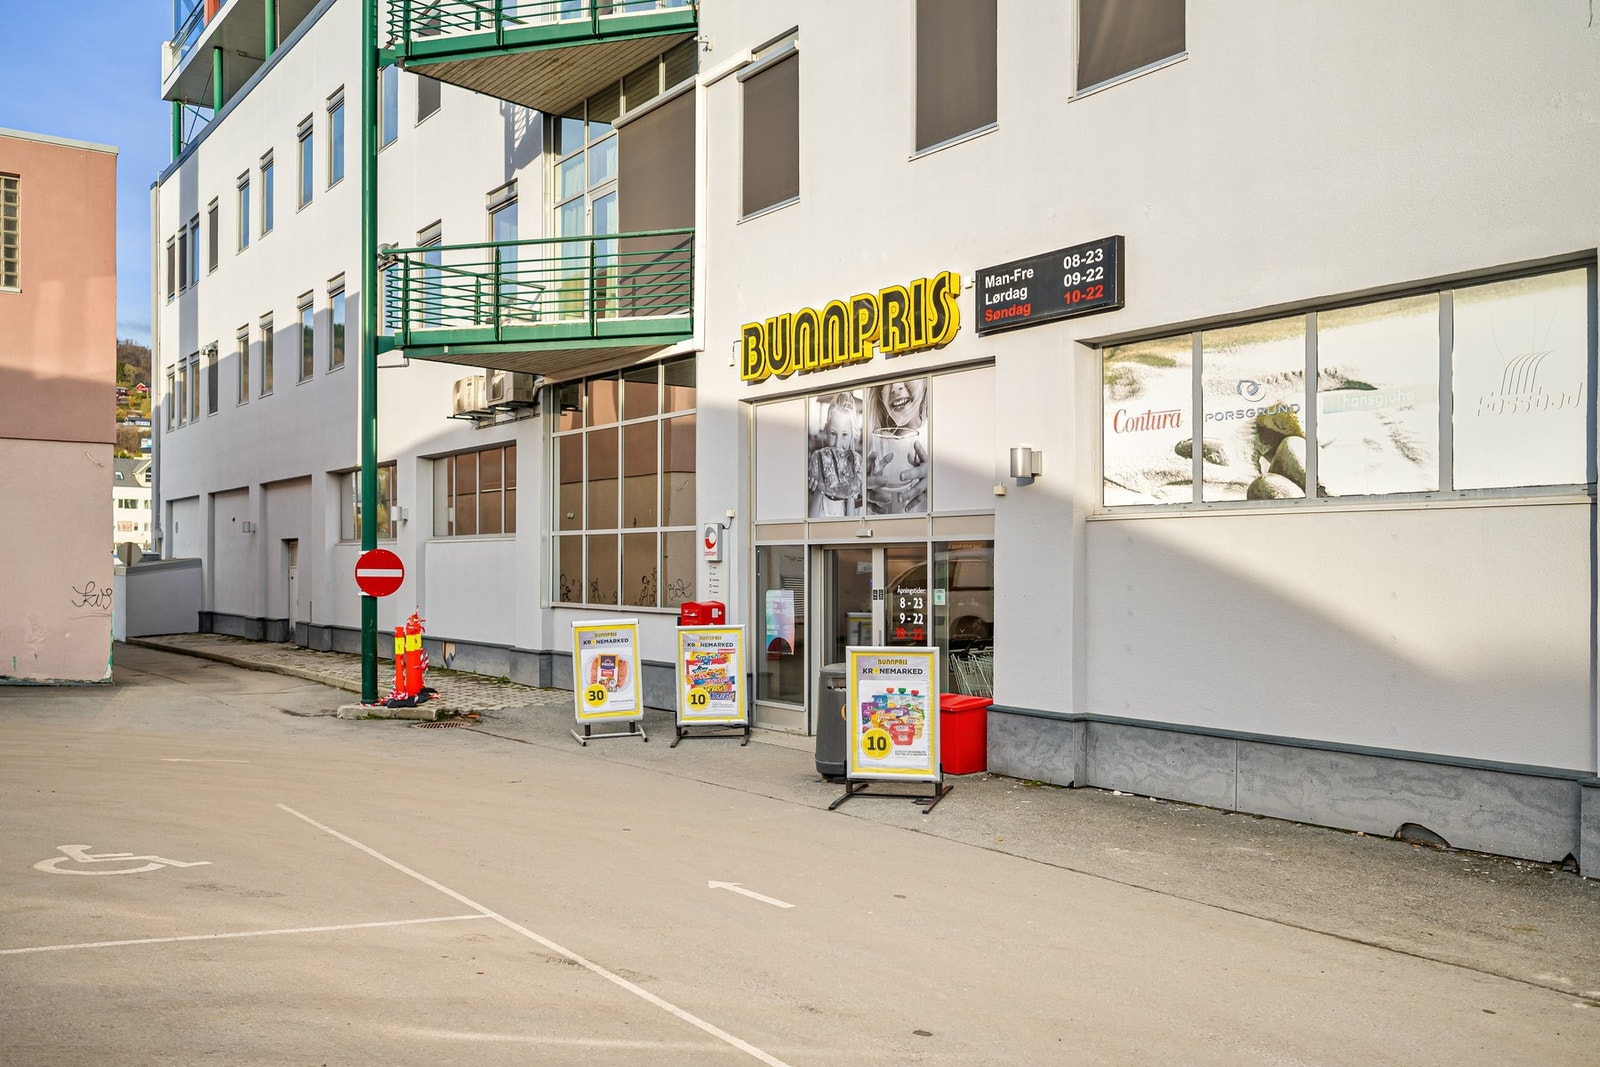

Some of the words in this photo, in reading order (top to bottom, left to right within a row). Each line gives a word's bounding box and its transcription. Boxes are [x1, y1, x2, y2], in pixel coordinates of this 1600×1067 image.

[985, 268, 1035, 289] Man-Fre
[1063, 248, 1104, 270] 08-23
[985, 287, 1028, 306] Lørdag
[1063, 266, 1104, 288] 09-22
[984, 303, 1031, 322] Søndag
[1063, 284, 1104, 305] 10-22
[741, 271, 960, 381] BUNNPRIS
[1343, 388, 1415, 409] hansgrohe
[1113, 408, 1182, 434] Contura
[1205, 403, 1301, 422] PORSGRUND
[900, 597, 906, 609] 8
[913, 597, 923, 609] 23
[899, 613, 906, 624] 9
[913, 613, 924, 625] 22
[588, 690, 604, 701] 30
[690, 694, 706, 705] 10
[867, 736, 887, 751] 10
